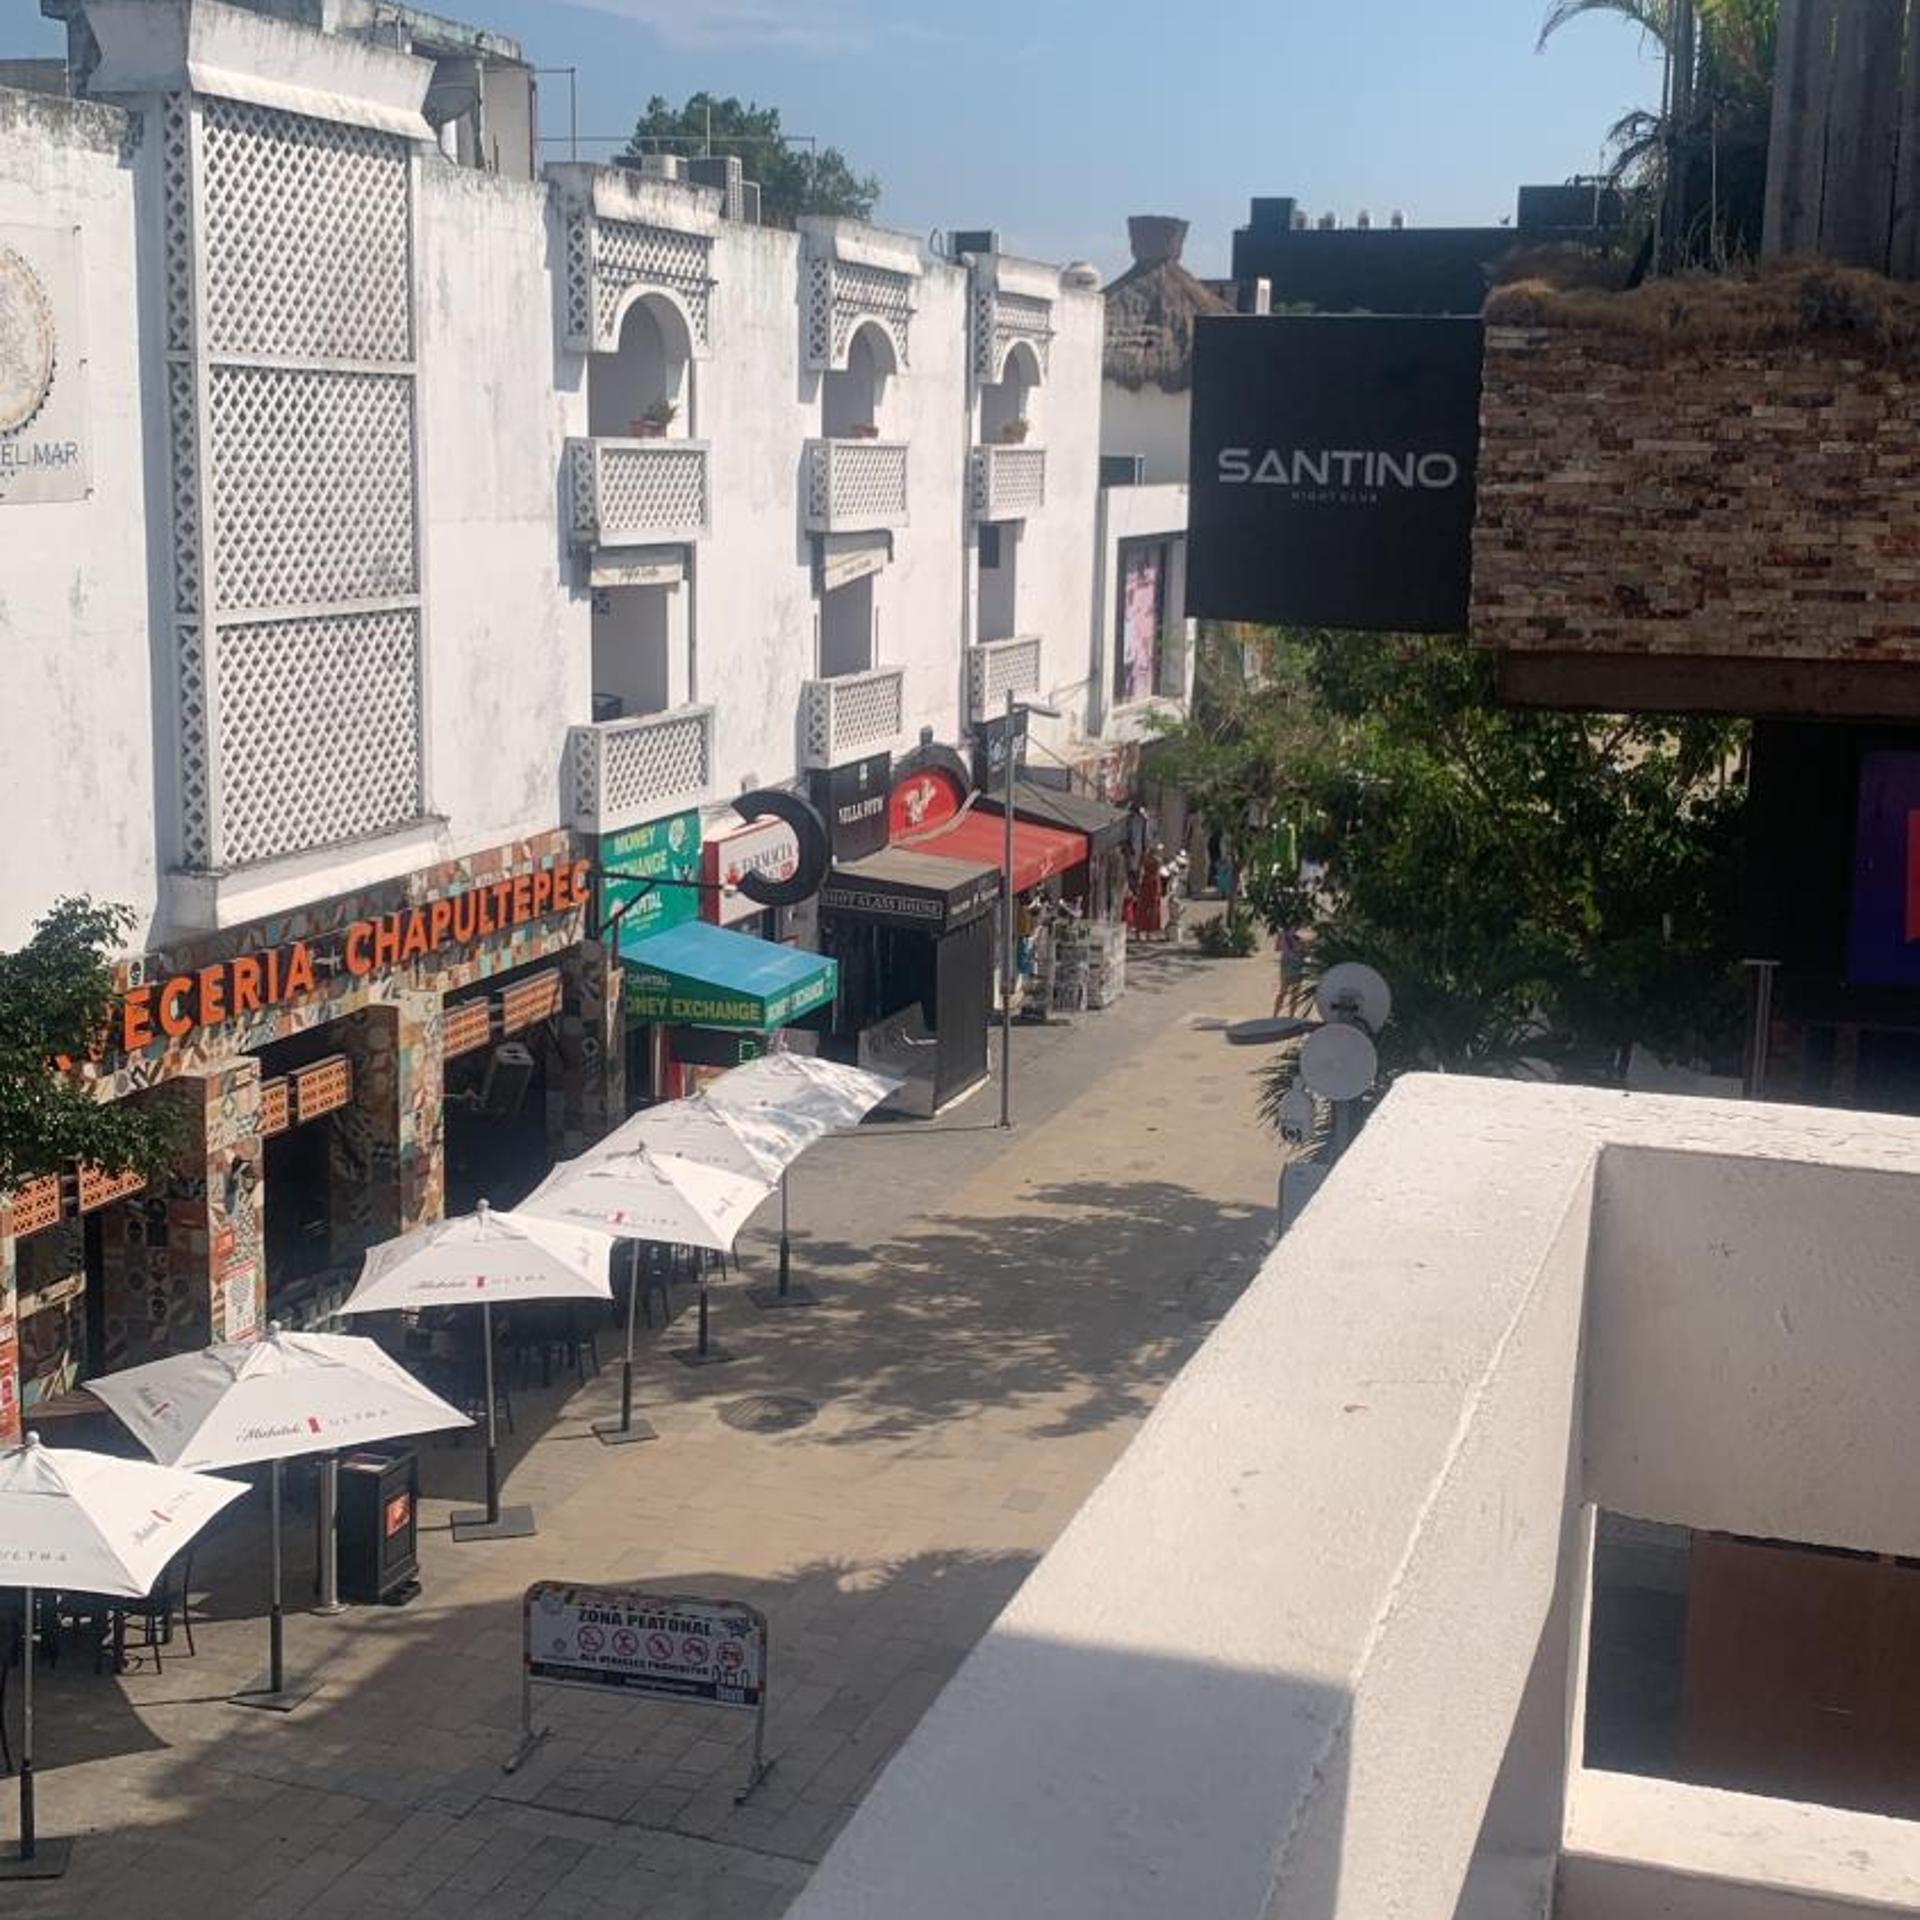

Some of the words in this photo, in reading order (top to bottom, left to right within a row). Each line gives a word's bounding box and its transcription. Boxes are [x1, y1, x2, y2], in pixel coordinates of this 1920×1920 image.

[33, 440, 79, 467] MAR
[1218, 448, 1457, 488] SANTINO
[613, 825, 656, 856] MONEY
[98, 942, 315, 1052] ECERIA
[345, 858, 590, 975] CHAPULTEPEC
[672, 1000, 761, 1021] EXCHANGE
[578, 1608, 623, 1627] ZONA
[626, 1613, 713, 1637] PEATONAL
